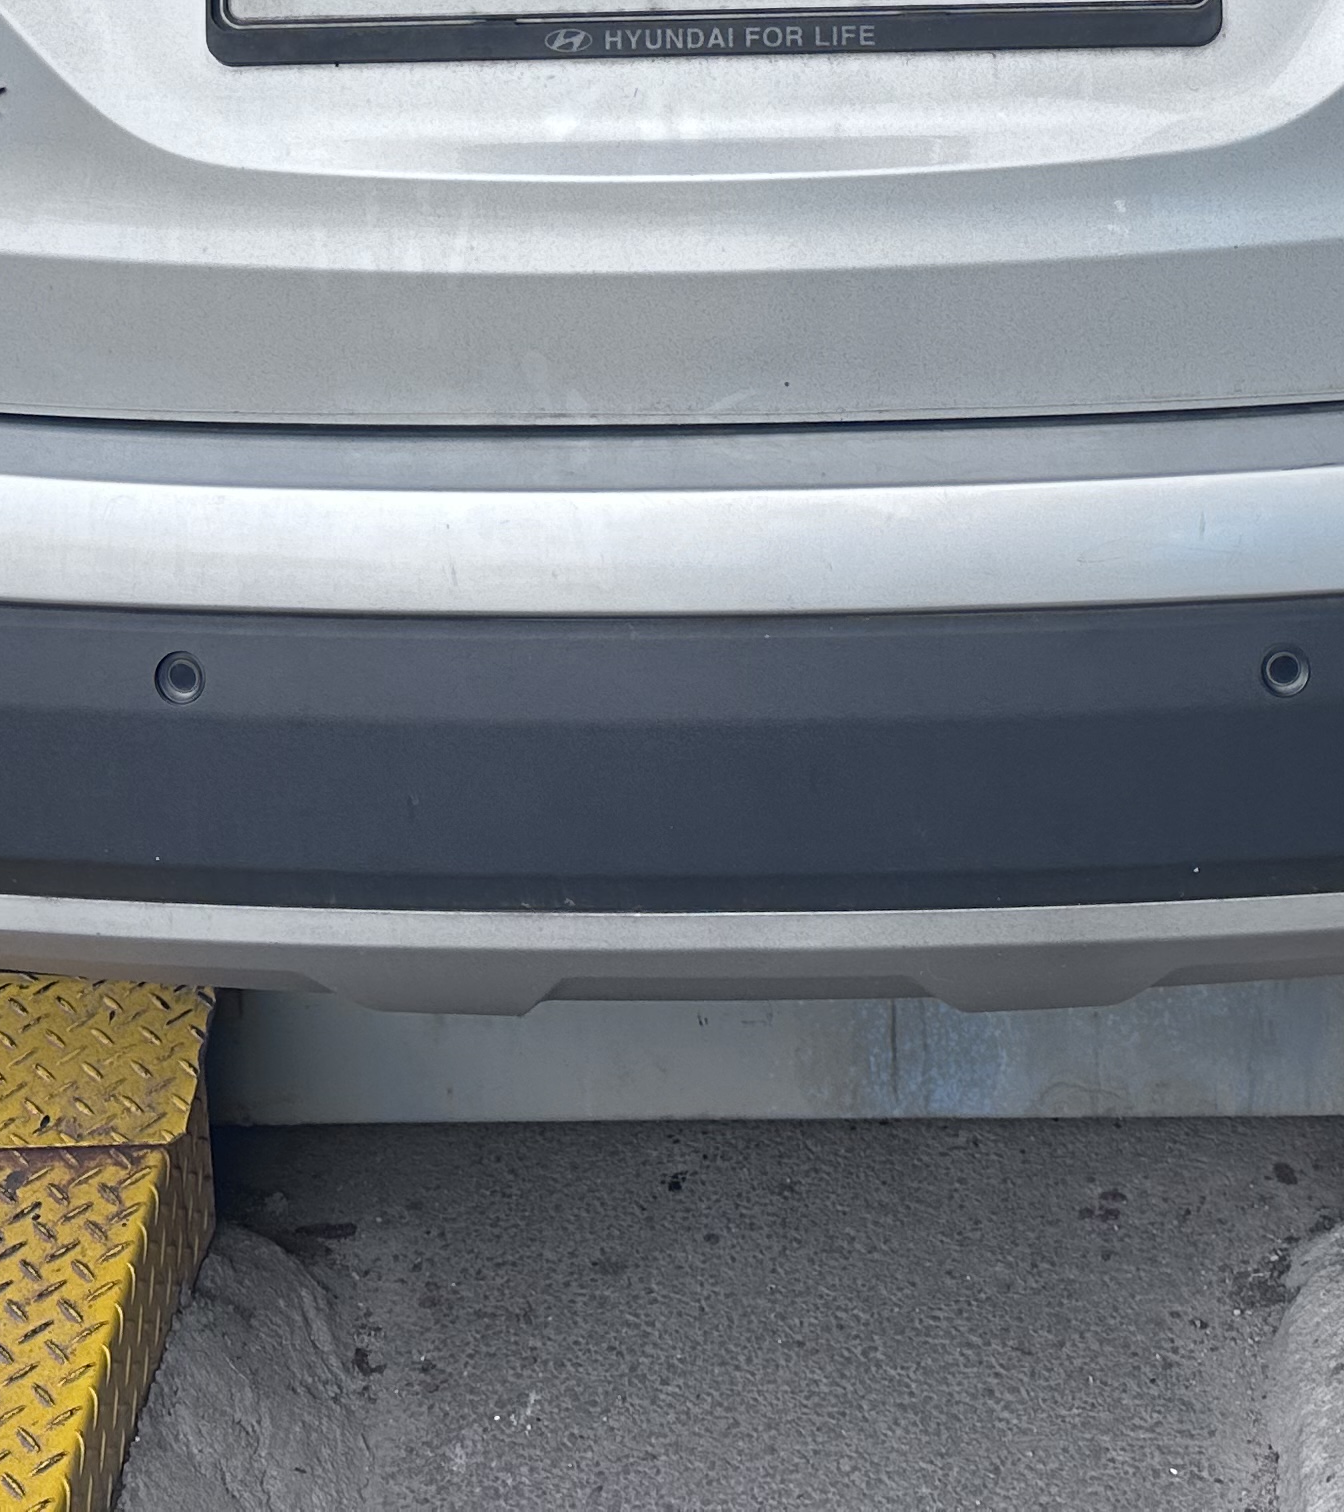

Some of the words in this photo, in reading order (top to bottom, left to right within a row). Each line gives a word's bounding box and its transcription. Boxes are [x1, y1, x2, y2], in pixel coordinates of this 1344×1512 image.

[605, 27, 734, 50] HYUNDAI
[745, 25, 804, 48] FOR
[815, 25, 876, 47] LIFE
